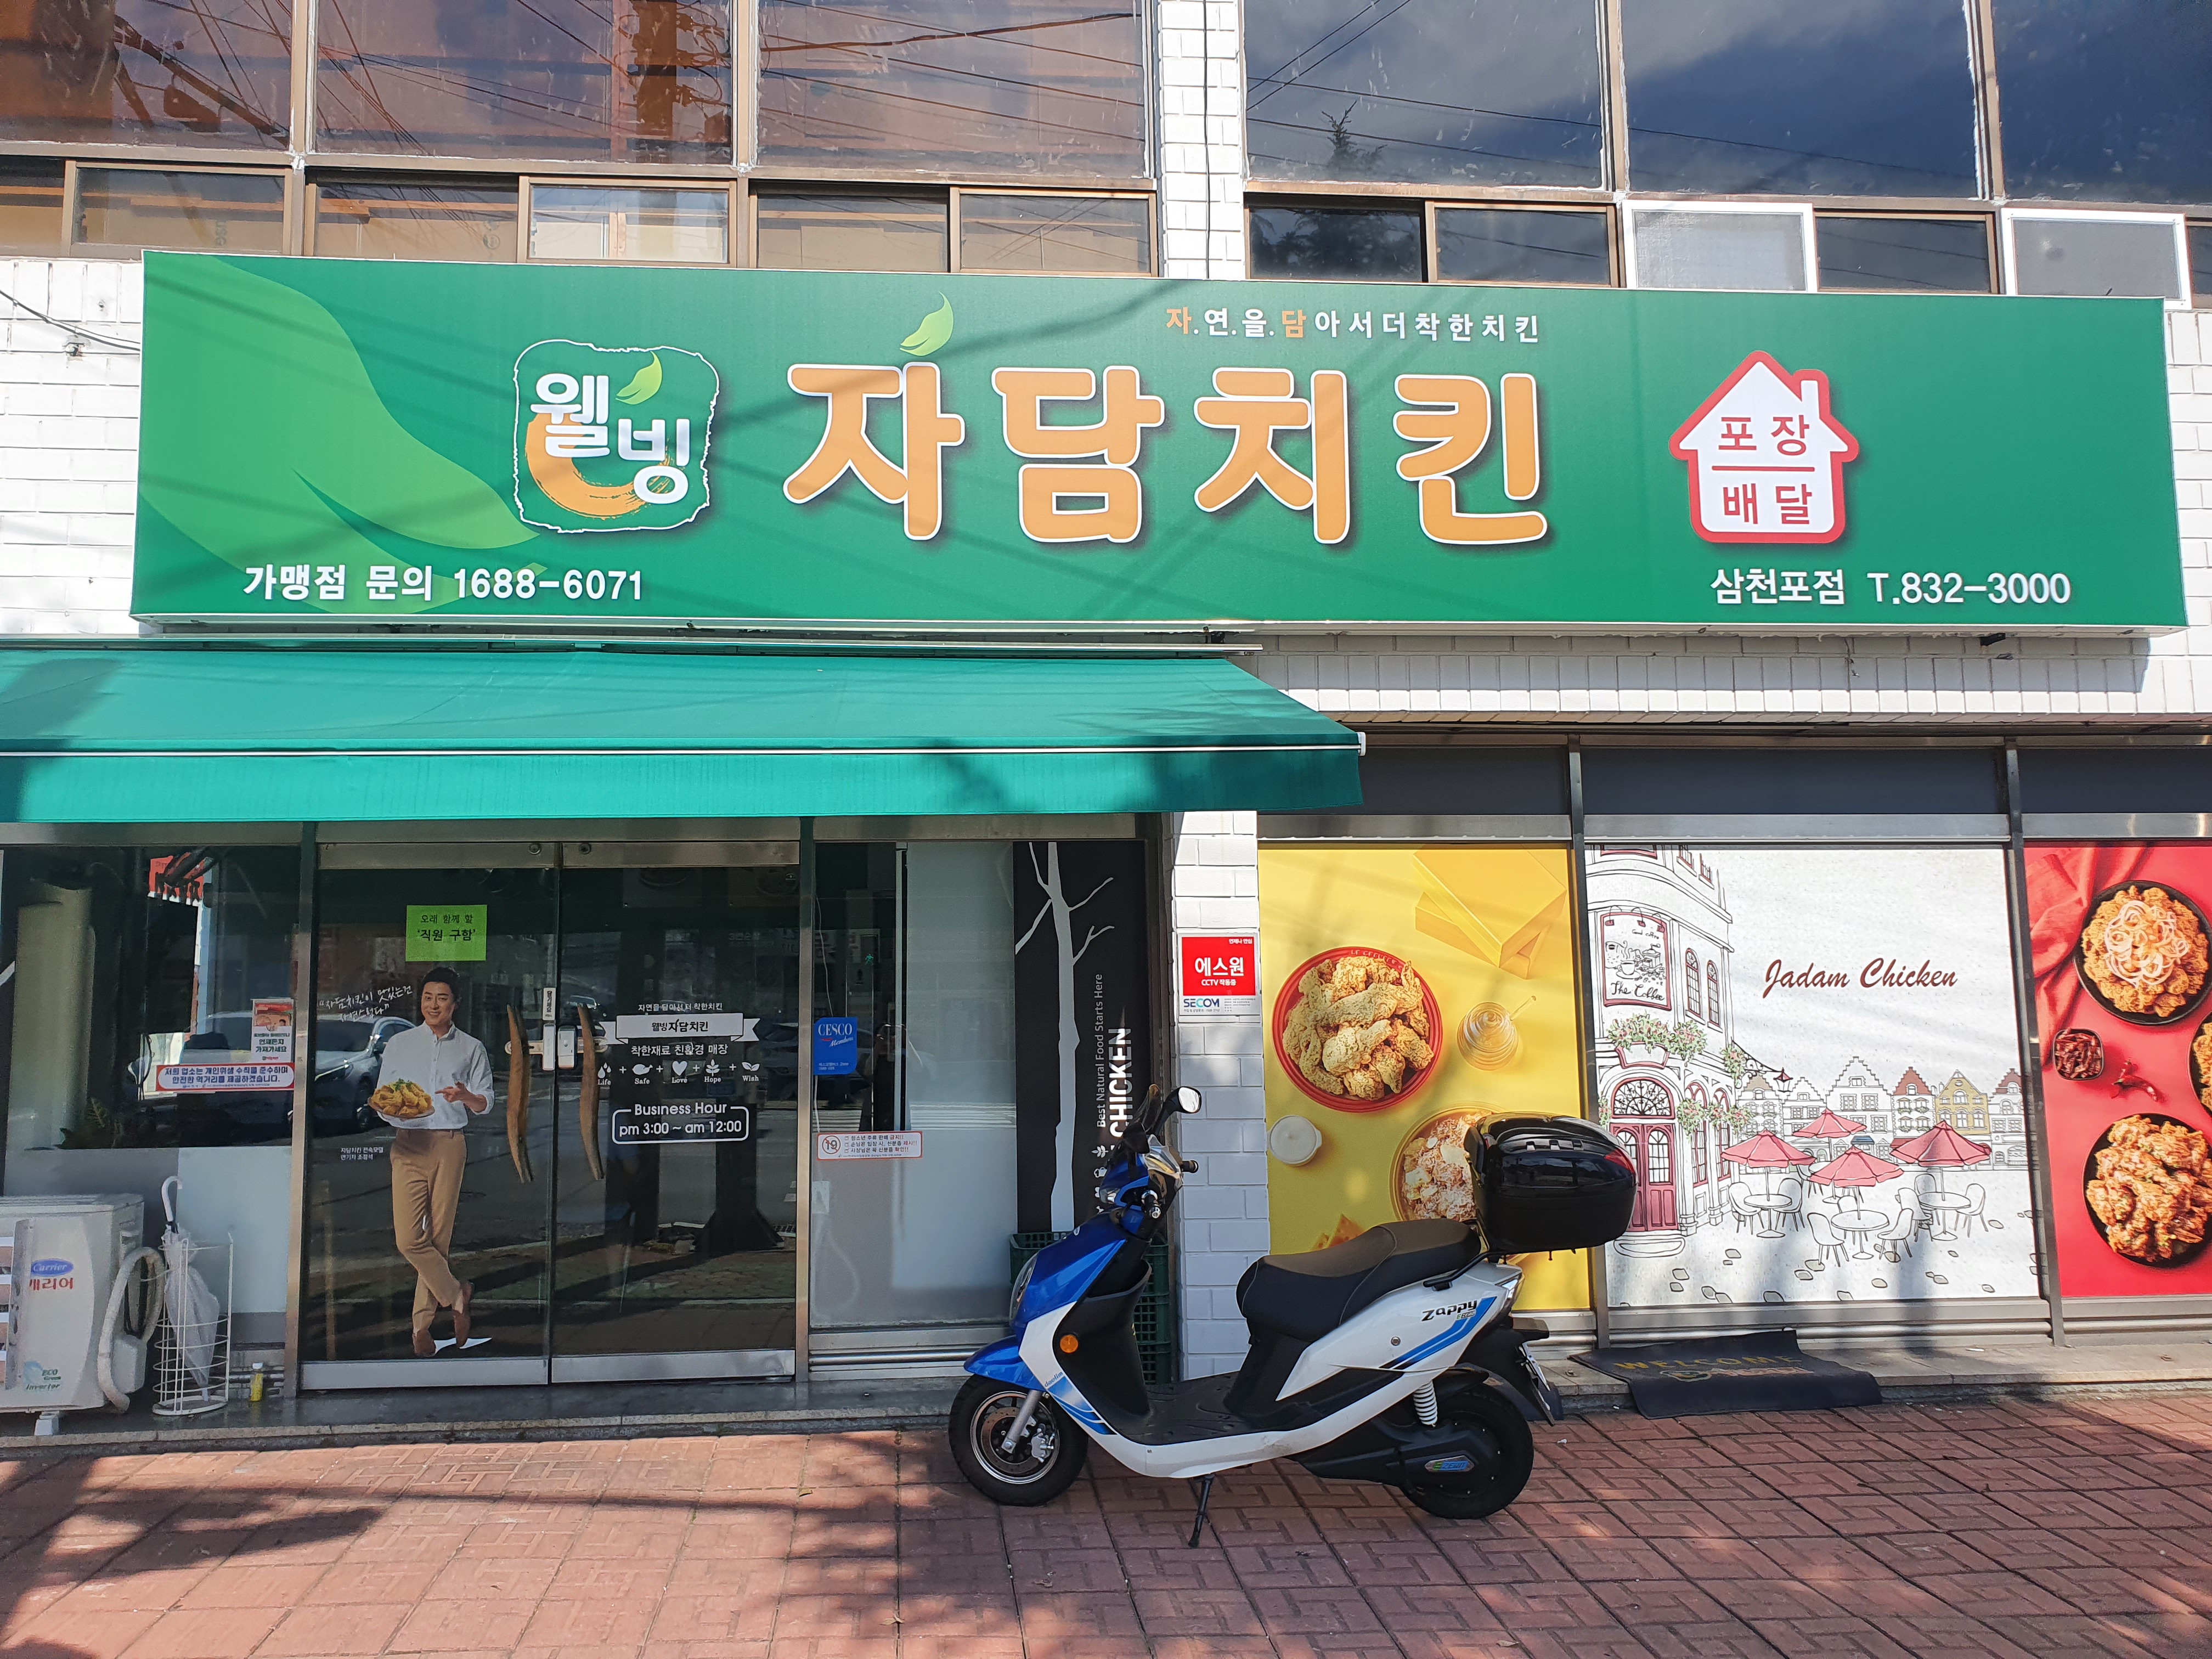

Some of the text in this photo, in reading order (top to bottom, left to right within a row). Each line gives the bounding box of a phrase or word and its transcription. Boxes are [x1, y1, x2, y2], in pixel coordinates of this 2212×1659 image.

[530, 373, 691, 505] 웰빙
[1718, 415, 1810, 456] 포장
[782, 361, 1548, 544] 자담치킨
[1723, 483, 1813, 524] 배달
[243, 563, 641, 602] 가맹점 문의 1688-6071
[1710, 568, 2072, 606] 삼천포점 T.832-3000
[421, 915, 473, 924] 오래 함께 할
[1194, 957, 1244, 977] 에스원
[1762, 957, 1957, 999] Jadam Chicken
[1610, 981, 1631, 995] The
[1183, 998, 1220, 1008] SECOM
[818, 1023, 853, 1036] CESCO
[631, 1043, 729, 1057] 착한재료 친환경 매장
[1094, 974, 1105, 1128] Best Natural Food Starts Here
[704, 1076, 721, 1085] Hope
[1108, 1028, 1133, 1138] CHICKEN
[634, 1102, 727, 1116] Business Hour
[619, 1125, 640, 1137] pm
[643, 1122, 669, 1135] 3:00
[685, 1123, 705, 1133] am
[709, 1120, 742, 1133] 12:00
[33, 1263, 67, 1271] Carrier
[1613, 1356, 1803, 1369] WELCOME
[1045, 1371, 1063, 1387] daelim
